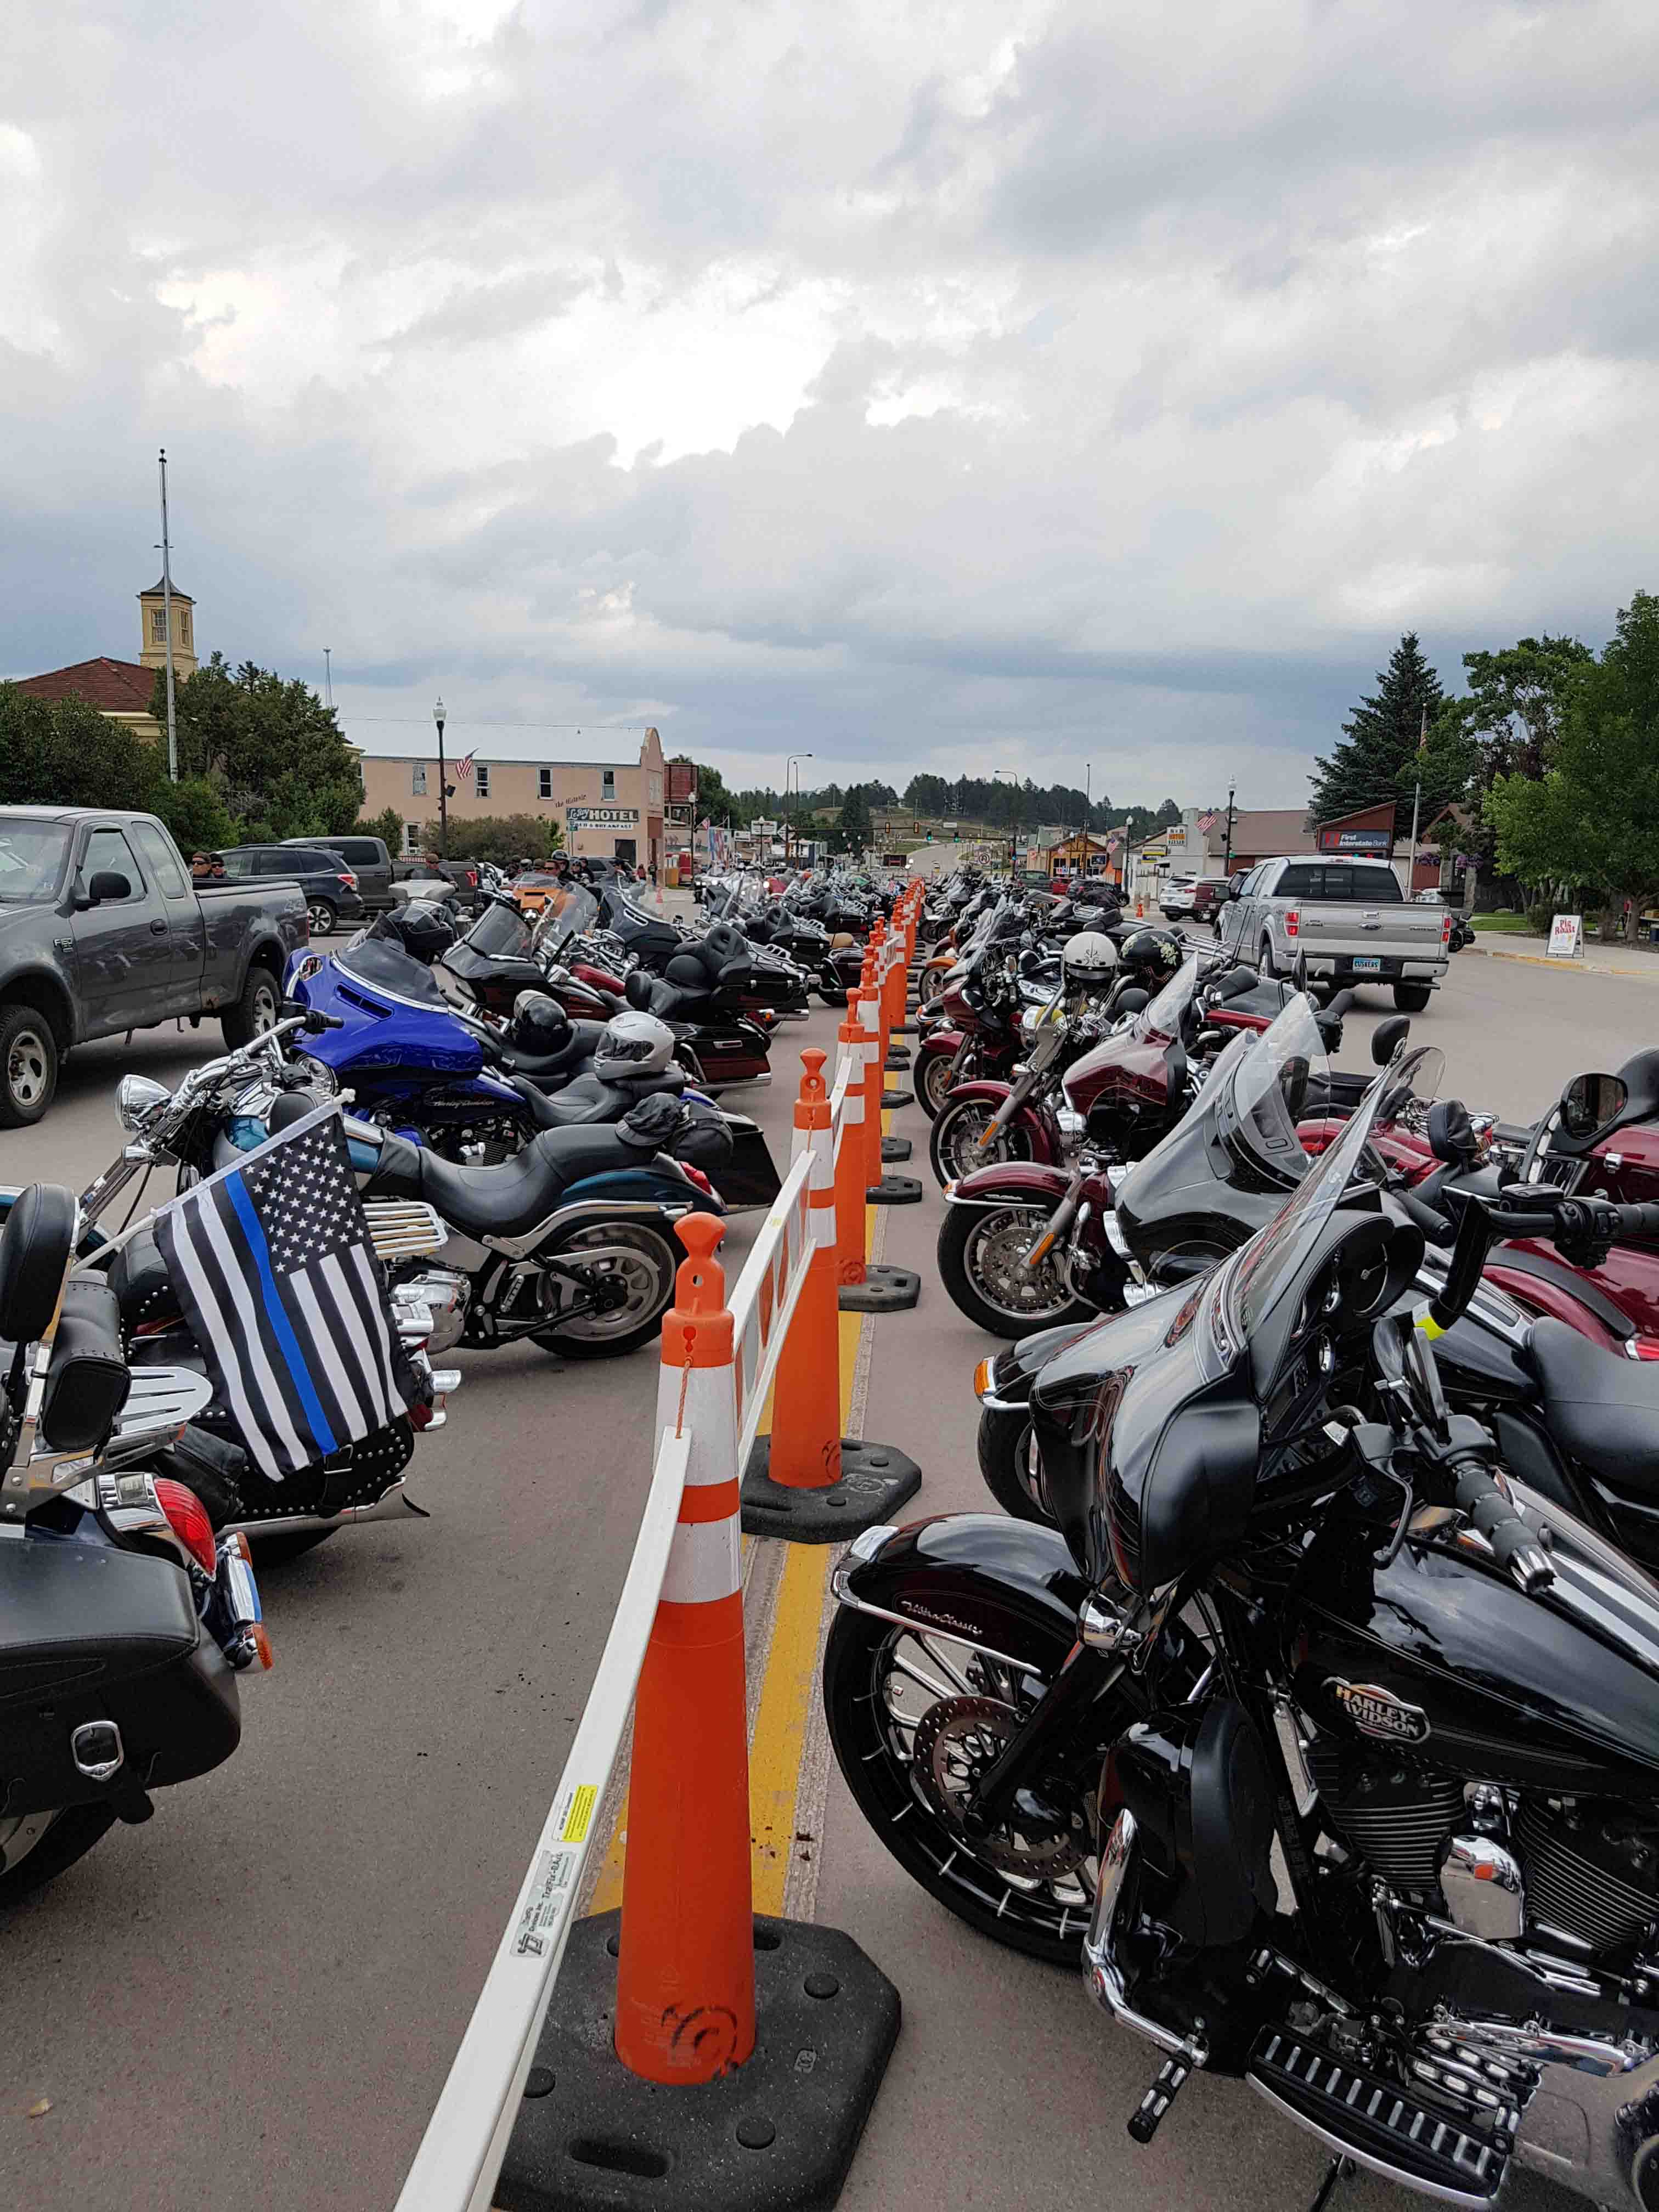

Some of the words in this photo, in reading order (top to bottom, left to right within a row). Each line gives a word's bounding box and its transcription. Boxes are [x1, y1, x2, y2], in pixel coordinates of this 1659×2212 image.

[589, 810, 637, 821] HOTEL
[1335, 1685, 1415, 1723] HARLEY-
[1343, 1701, 1419, 1736] AVIDSON
